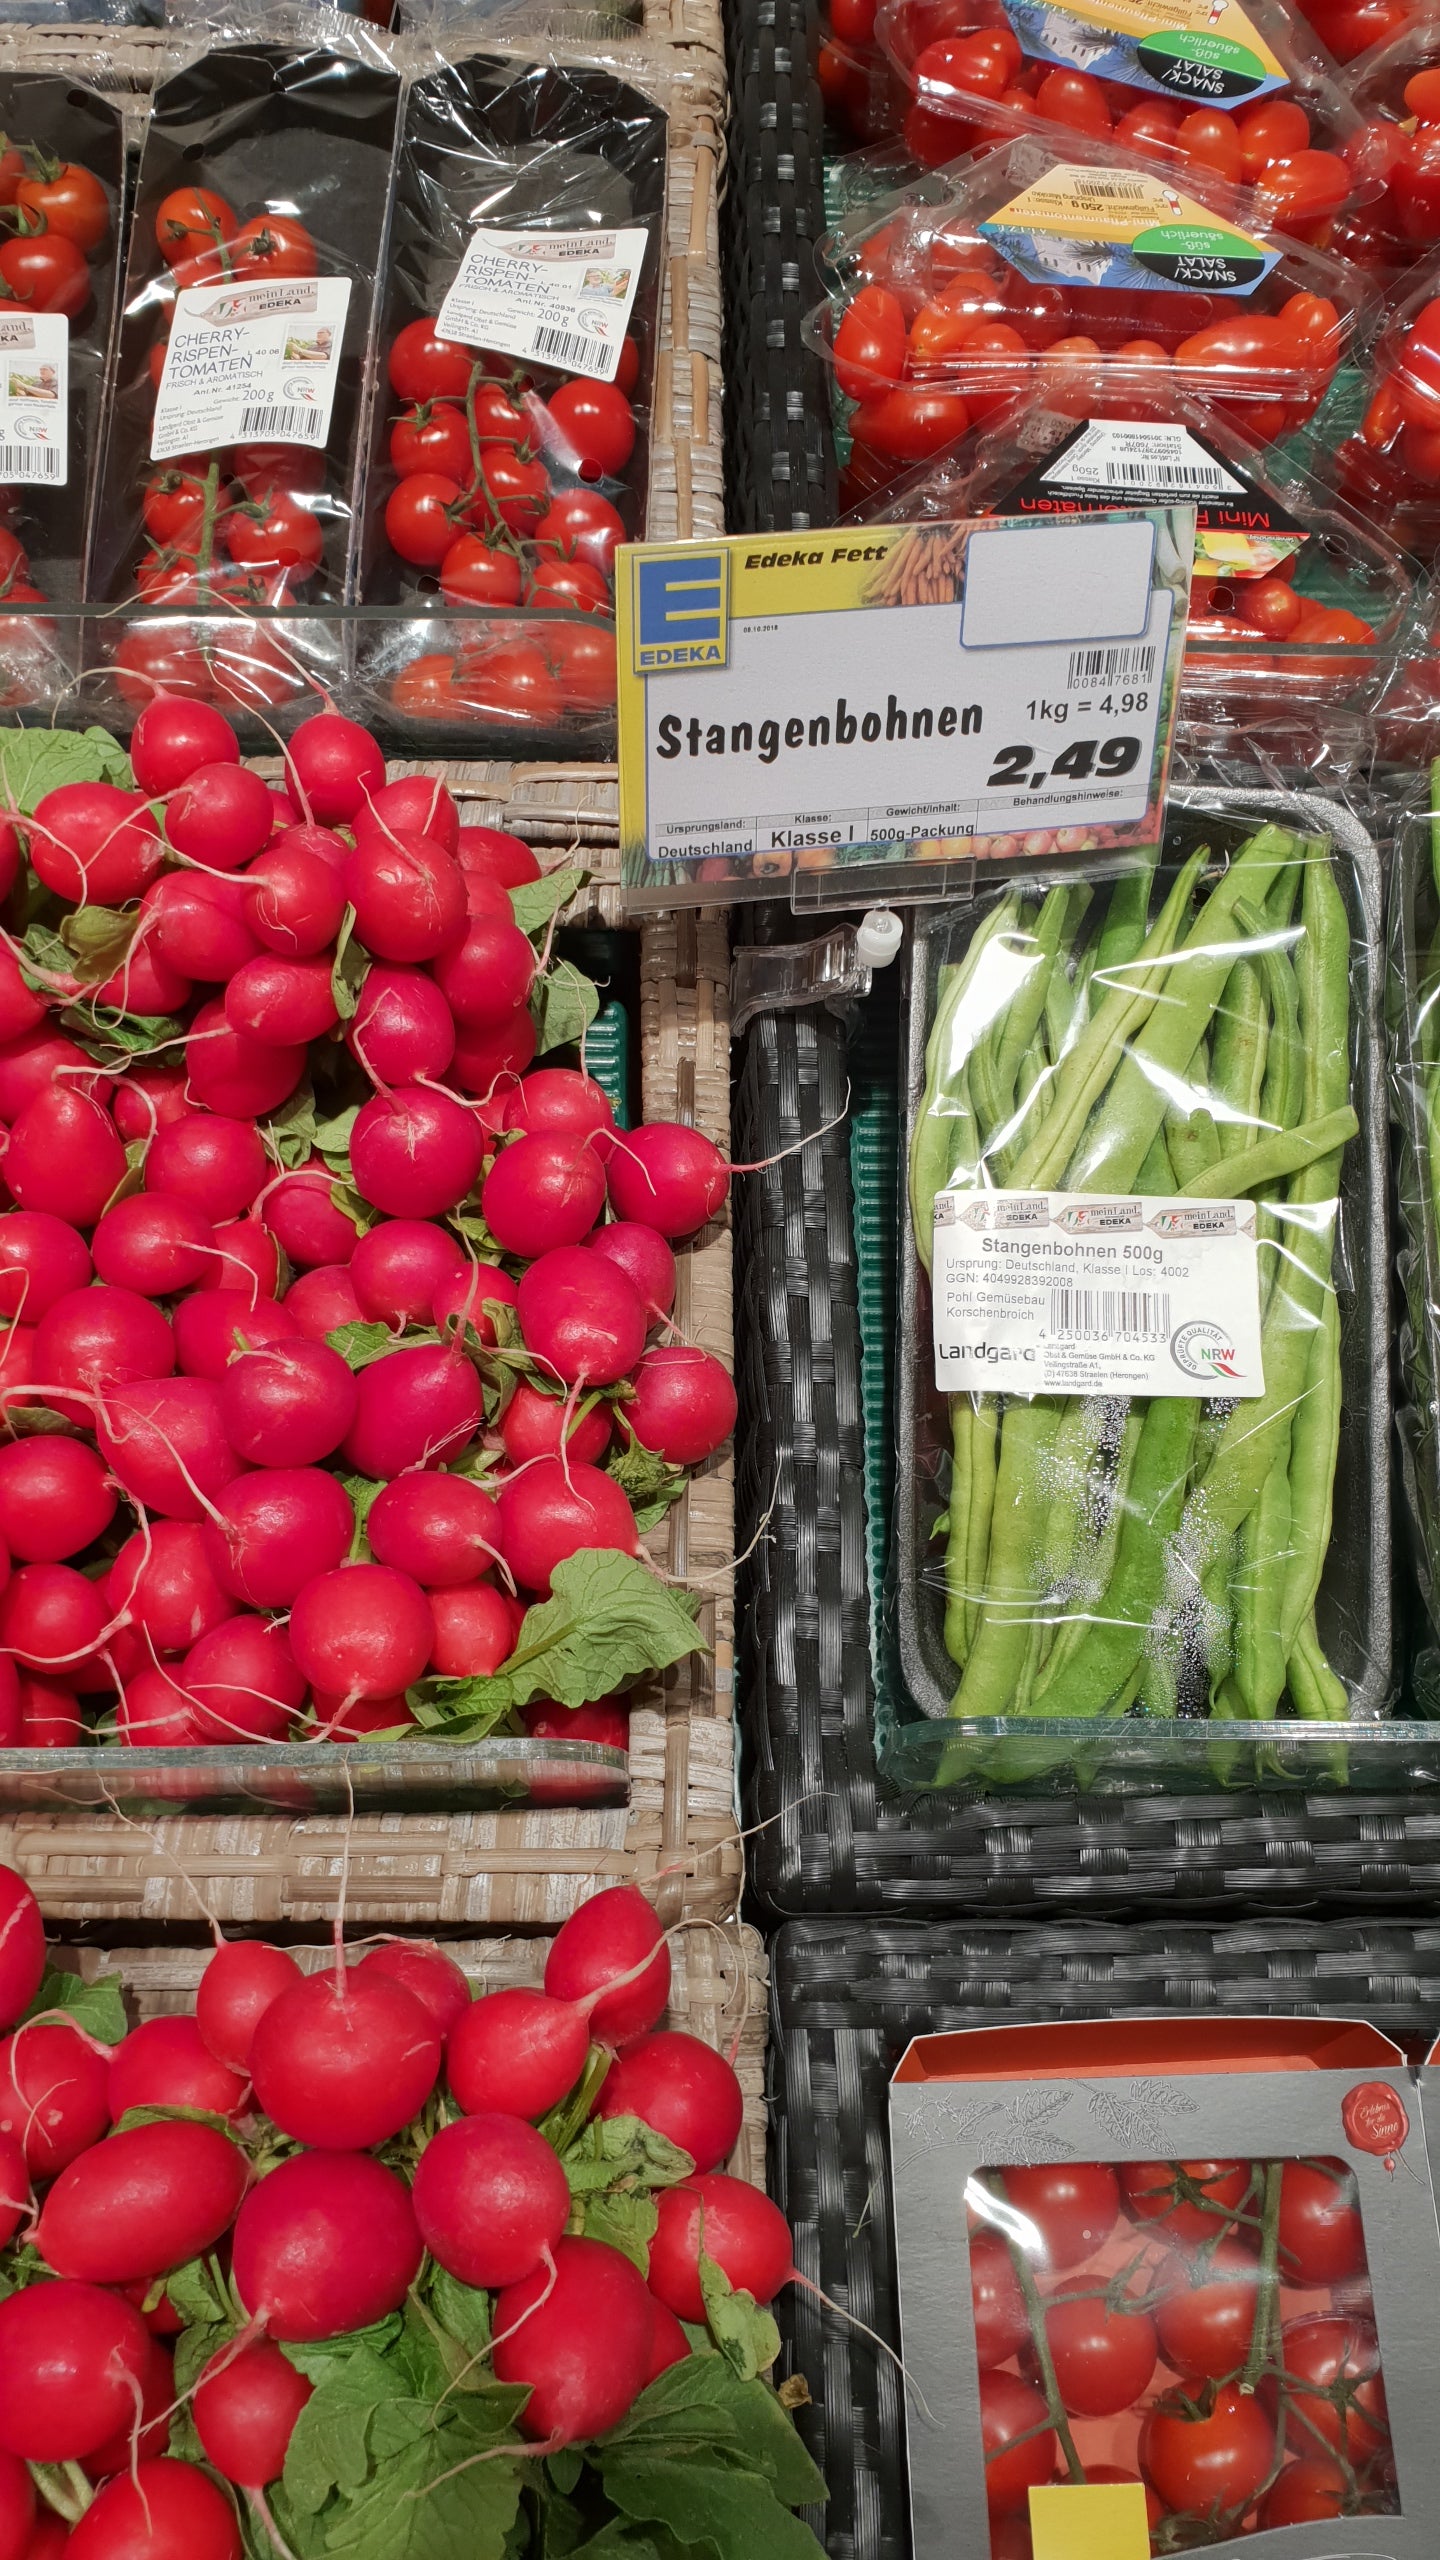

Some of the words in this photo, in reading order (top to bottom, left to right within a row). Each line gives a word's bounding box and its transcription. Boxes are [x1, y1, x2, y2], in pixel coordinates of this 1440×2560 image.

[1179, 33, 1241, 54] säuerlich
[1191, 47, 1220, 60] süß-
[1174, 59, 1224, 80] SALAT
[1161, 69, 1225, 94] SNACK/
[1071, 200, 1079, 209] g
[1080, 202, 1104, 212] 250
[1160, 229, 1224, 242] säuerlich
[558, 248, 600, 257] EDEKA
[1180, 239, 1211, 251] süß-
[470, 253, 549, 273] CHERRY-
[1177, 255, 1226, 270] SALAT
[465, 264, 535, 281] RISPEN-
[1173, 267, 1237, 282] SNACK/
[463, 275, 550, 294] TOMATEN
[259, 298, 302, 310] EDEKA
[500, 289, 560, 302] AROMATISCH
[537, 309, 561, 322] 200
[561, 315, 569, 328] g
[174, 327, 250, 348] CHERRY-
[171, 343, 239, 365] RISPEN-
[169, 356, 253, 379] TOMATEN
[571, 359, 605, 376] 047659
[165, 377, 197, 390] FRISCH
[206, 370, 263, 385] AROMATISCH
[242, 389, 265, 402] 200
[267, 390, 275, 403] g
[241, 430, 276, 439] 313705
[279, 430, 316, 441] 047659
[18, 471, 56, 480] 047659
[1072, 463, 1099, 476] 250g
[1220, 511, 1270, 529] Mini
[744, 550, 824, 570] Edeka
[831, 545, 888, 564] Fett
[640, 557, 721, 645] E
[743, 624, 778, 633] 08.10.2018
[640, 645, 721, 666] EDEKA
[1026, 699, 1069, 724] 1kg
[1077, 701, 1092, 712] =
[1099, 691, 1149, 718] 4,98
[656, 694, 983, 764] Stangenbohnen
[986, 736, 1143, 789] 2,49
[666, 819, 747, 835] Ursprungsland:
[794, 812, 832, 824] Klasse:
[886, 803, 960, 817] Gewicht/Inhalt:
[1013, 789, 1123, 807] Behandlungshinweise:
[658, 839, 753, 859] Deutschland
[771, 828, 842, 849] Klasse
[849, 825, 855, 842] I
[870, 823, 975, 843] 500g-Packung
[1006, 1213, 1038, 1221] EDEKA
[1099, 1218, 1131, 1226] EDEKA
[1193, 1221, 1225, 1230] EDEKA
[982, 1238, 1117, 1258] Stangenbohnen
[1123, 1245, 1163, 1264] 500g
[946, 1258, 1002, 1271] Ursprung:
[1005, 1259, 1079, 1274] Deutschland,
[1083, 1263, 1121, 1276] Klasse
[1132, 1265, 1157, 1277] Los:
[1160, 1266, 1190, 1278] 4002
[946, 1273, 979, 1283] GGN:
[982, 1273, 1073, 1287] 4049928392008
[947, 1292, 972, 1303] Pohl
[976, 1292, 1046, 1305] Gemüsebau
[946, 1307, 1035, 1320] Korschenbroich
[1039, 1329, 1047, 1339] 4
[1057, 1329, 1109, 1341] 250036
[1115, 1331, 1167, 1343] 704533
[1068, 1351, 1097, 1360] Gemüse
[1201, 1348, 1236, 1361] NRW
[1109, 1371, 1149, 1380] (Herongen)
